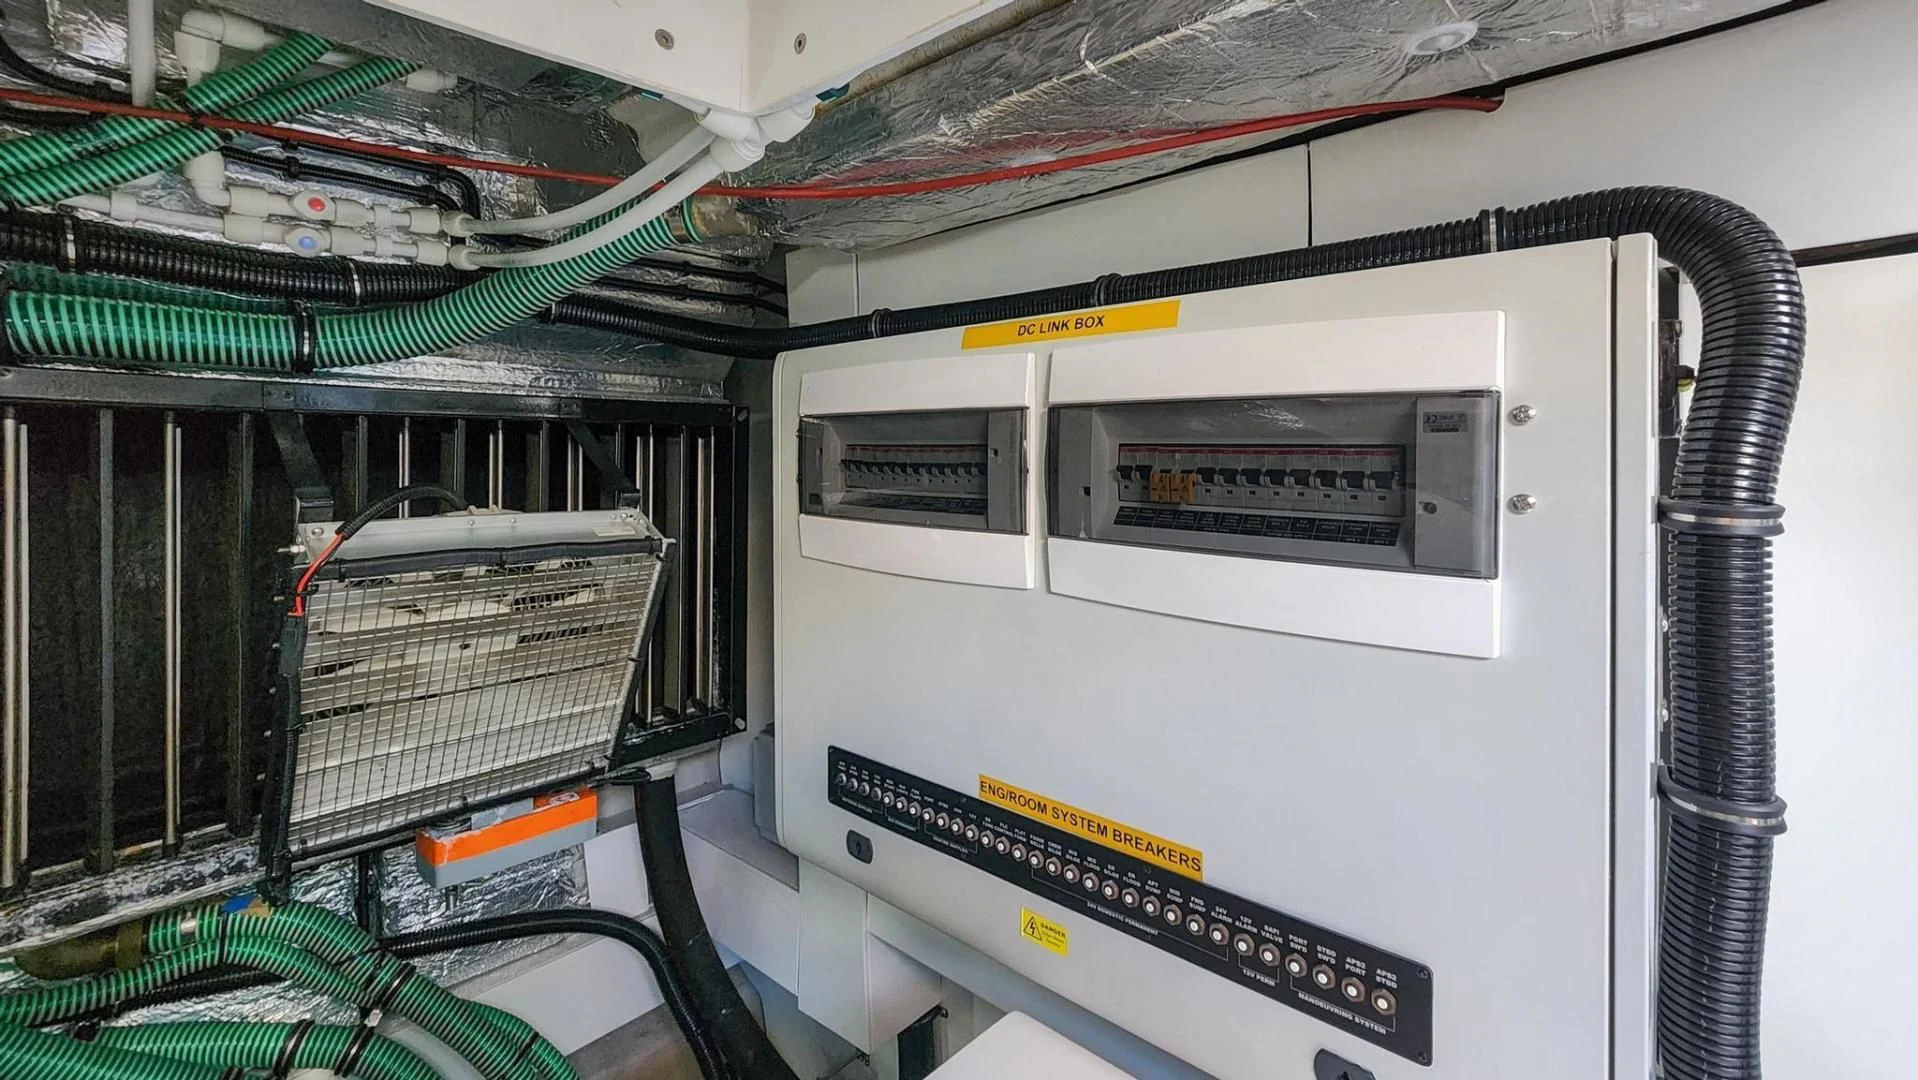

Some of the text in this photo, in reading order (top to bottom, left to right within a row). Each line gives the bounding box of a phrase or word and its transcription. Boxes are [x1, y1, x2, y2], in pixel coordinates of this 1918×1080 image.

[1017, 315, 1105, 337] DC LINK BOX
[980, 780, 1202, 872] ENG/ROOM SYSTEM BREAKERS
[1145, 885, 1162, 895] SUMP
[1147, 880, 1159, 888] AFT
[1166, 893, 1183, 904] SUMP
[1190, 896, 1205, 906] FWD
[1188, 902, 1206, 913] SUMP
[1215, 906, 1228, 915] 24V
[1097, 904, 1124, 922] DOMESTIC
[1124, 917, 1159, 936] PERMANENT
[1210, 911, 1233, 924] ALARM
[1240, 915, 1253, 924] 12V
[1040, 922, 1066, 939] DANGER
[1235, 920, 1258, 934] ALARM
[1260, 930, 1284, 944] VALVE
[1288, 934, 1308, 946] PORT
[1316, 945, 1337, 958] STBD
[1345, 957, 1367, 969] APS2
[1345, 964, 1367, 976] PORT
[1376, 968, 1398, 982] APS2
[1242, 968, 1276, 987] 12V PERM
[1375, 976, 1398, 989] STBD
[1298, 992, 1386, 1035] MANOEUVRING SYSTEM
